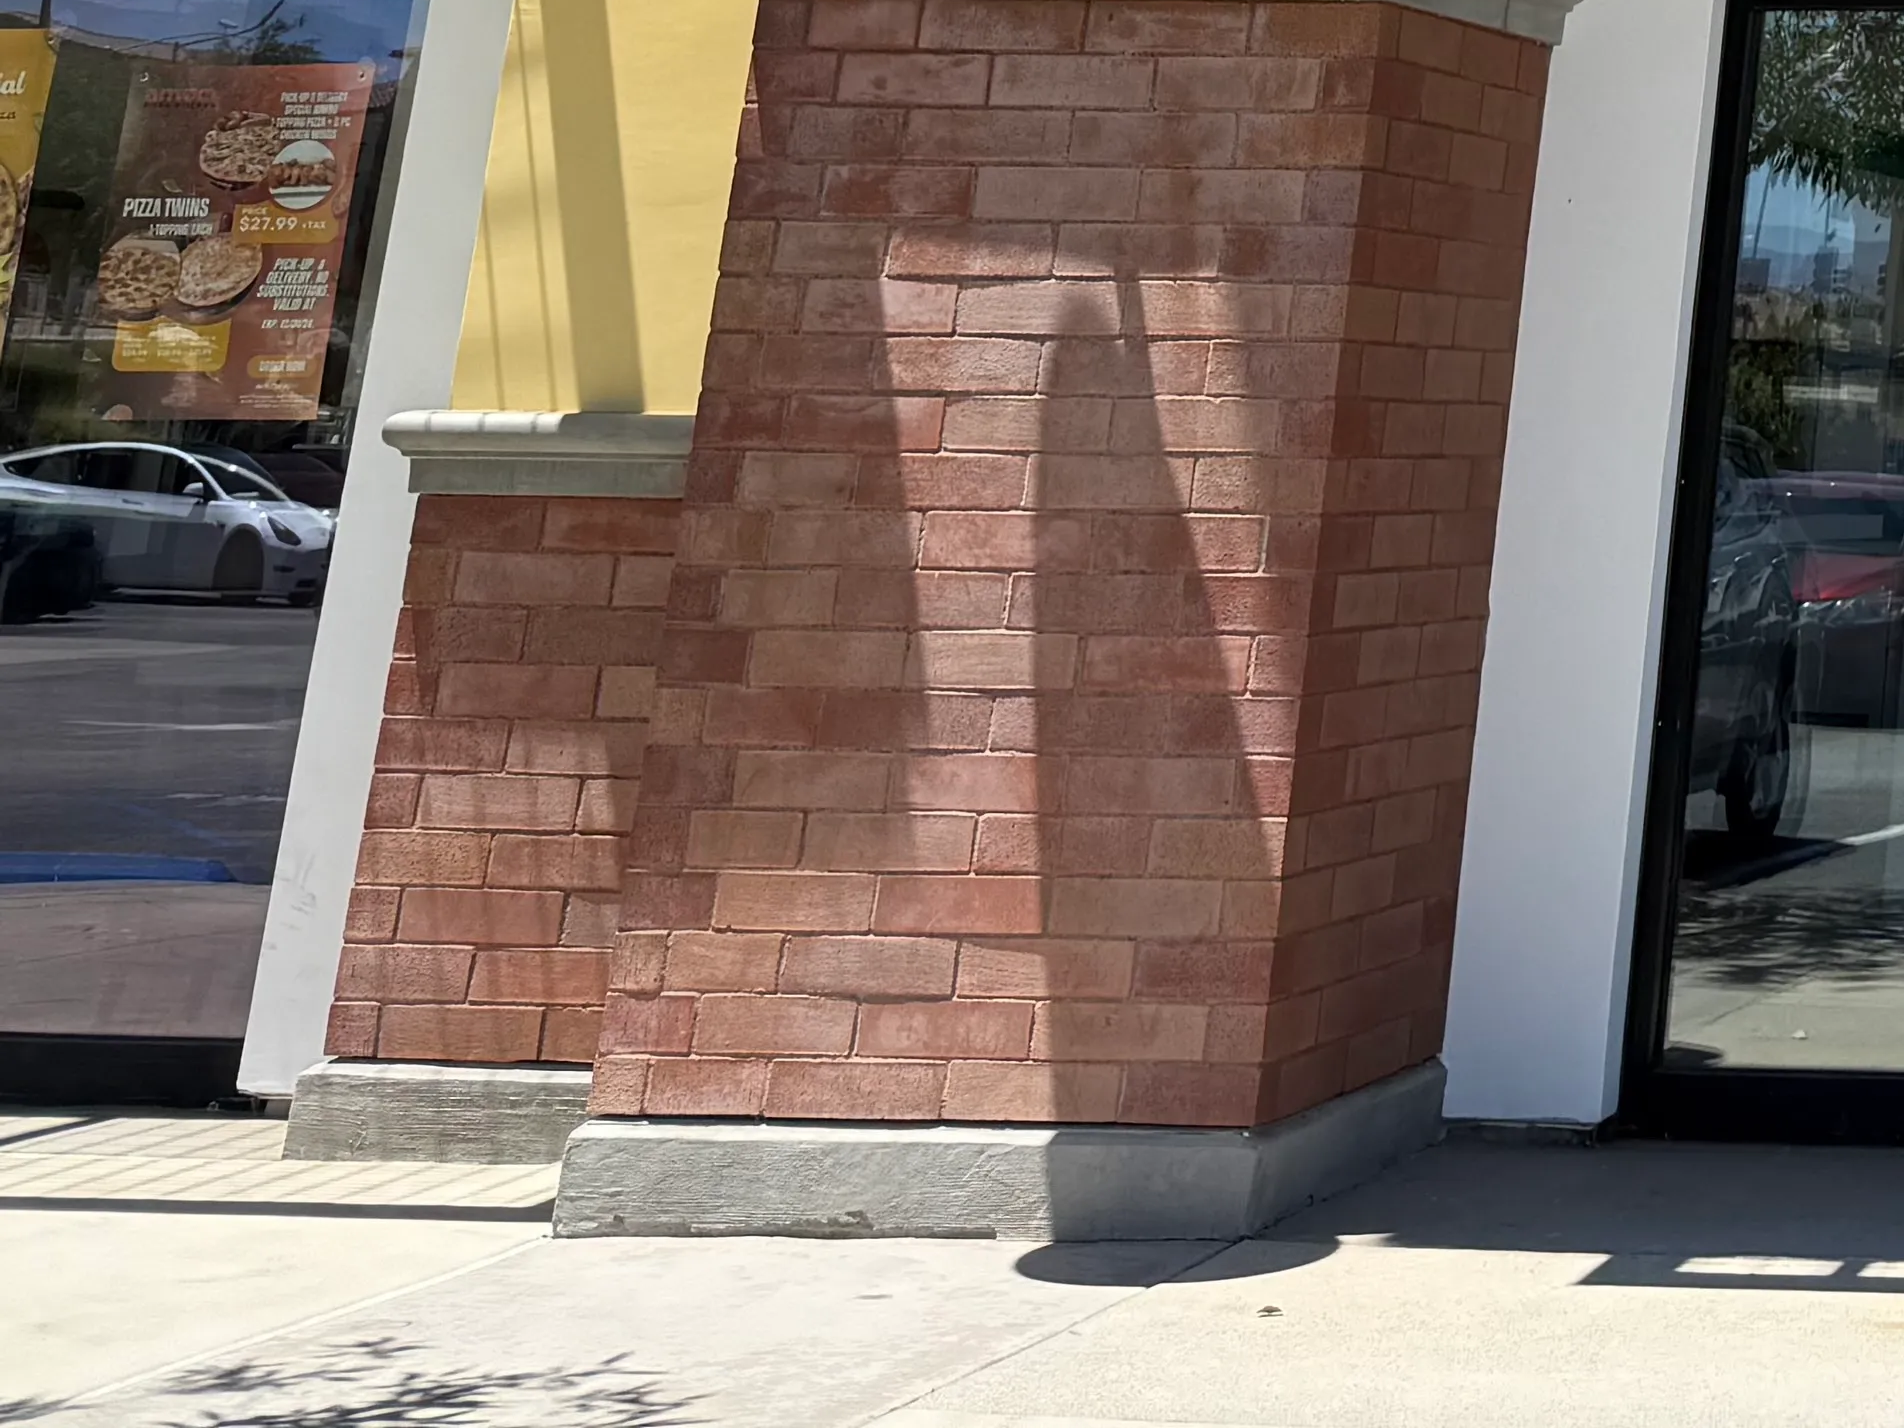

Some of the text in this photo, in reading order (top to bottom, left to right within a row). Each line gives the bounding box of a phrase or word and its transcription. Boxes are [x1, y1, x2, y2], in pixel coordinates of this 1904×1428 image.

[123, 198, 210, 218] PIZZA TWINS
[240, 216, 298, 232] $27.99
